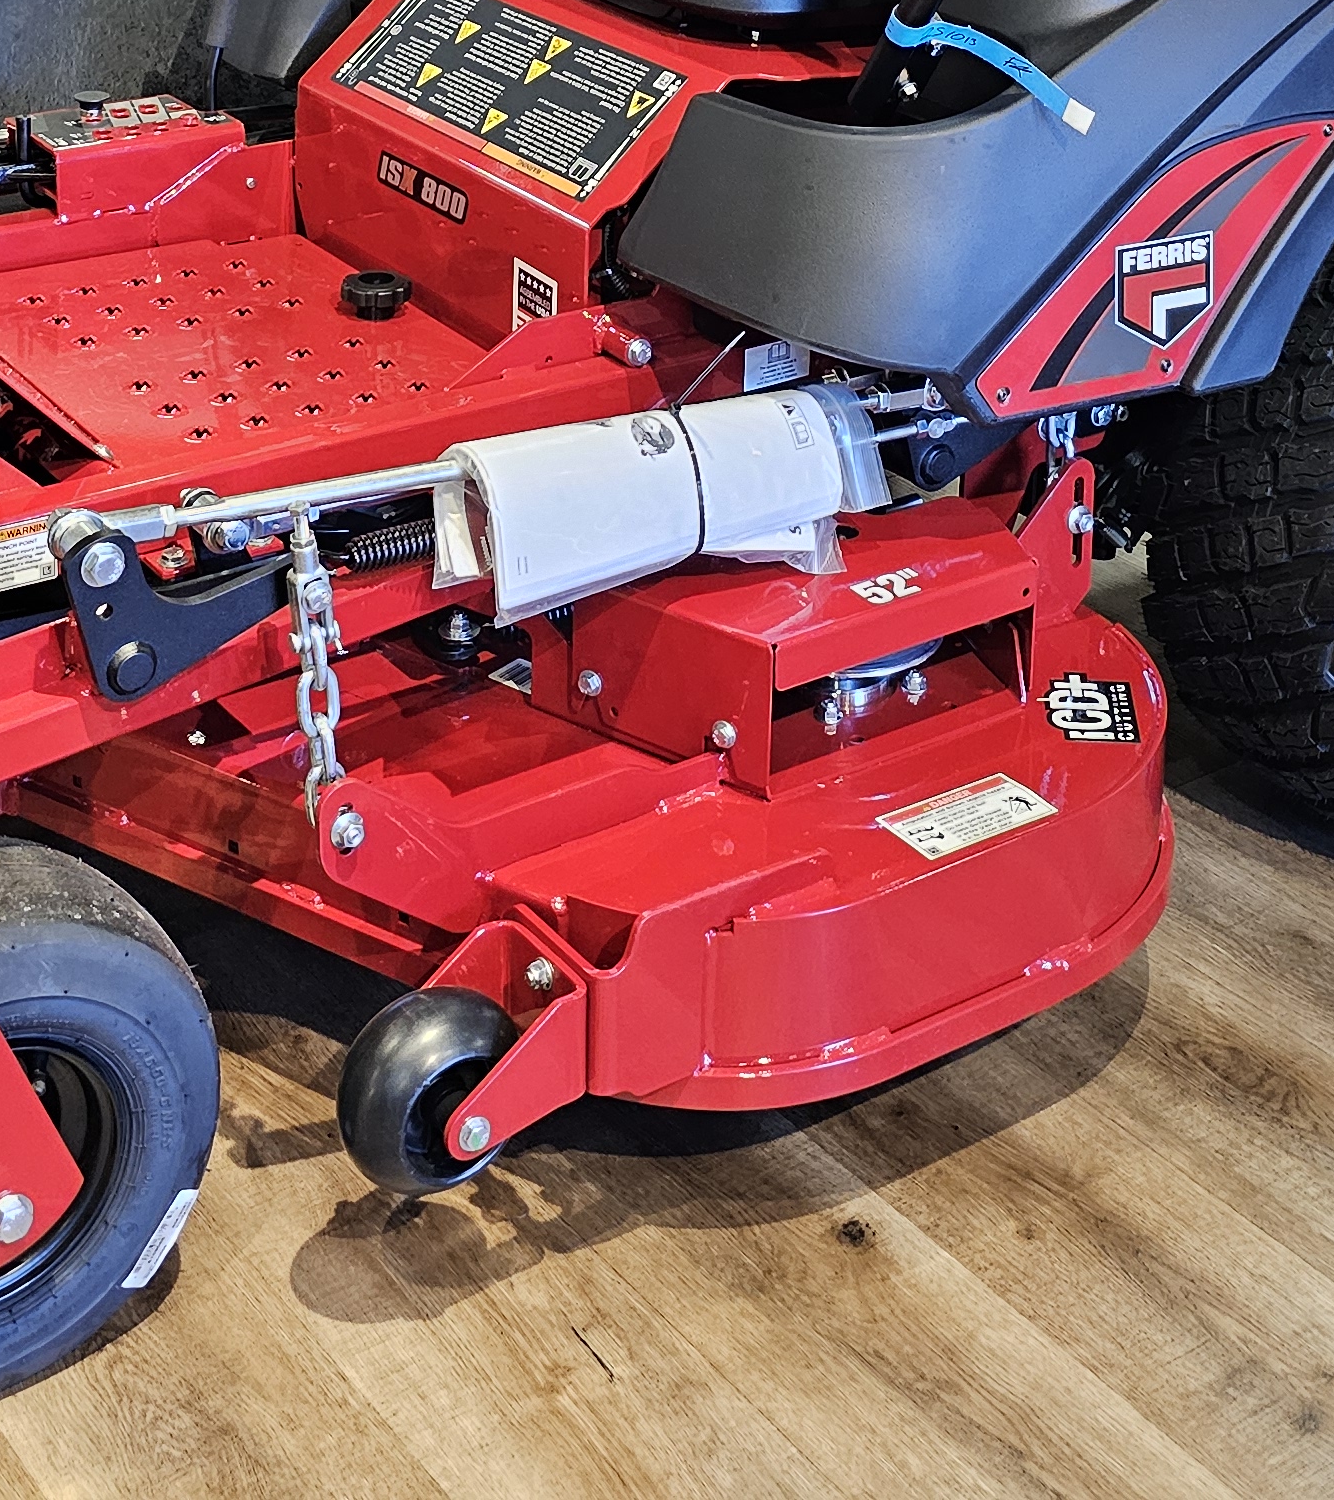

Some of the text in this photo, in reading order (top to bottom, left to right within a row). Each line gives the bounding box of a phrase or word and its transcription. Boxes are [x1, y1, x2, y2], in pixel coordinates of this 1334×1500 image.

[379, 154, 467, 220] ISX 800
[1122, 238, 1208, 274] FERRIS
[7, 522, 47, 539] WARNIN
[850, 567, 922, 605] 52"
[929, 790, 971, 810] DANGER
